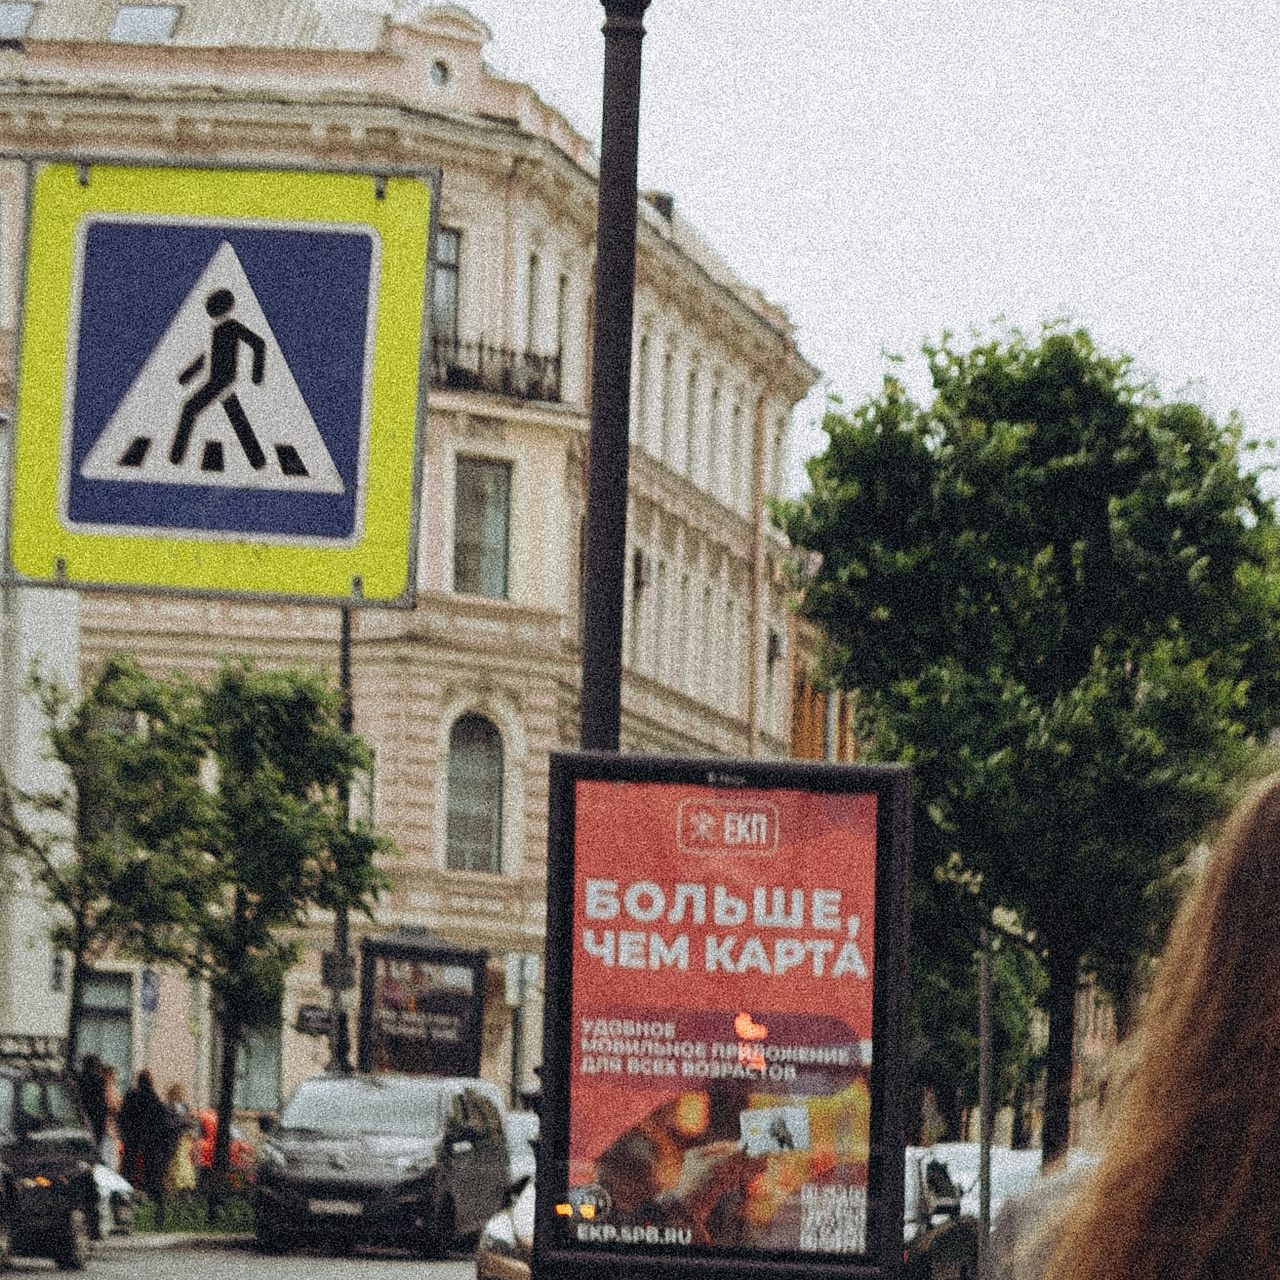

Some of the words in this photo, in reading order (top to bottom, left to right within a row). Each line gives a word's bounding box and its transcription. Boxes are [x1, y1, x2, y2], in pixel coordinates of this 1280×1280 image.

[723, 812, 768, 845] ЕКП
[584, 878, 861, 938] БОЛЬШЕ,
[582, 929, 690, 971] ЧЕМ
[704, 935, 868, 979] КАРТА
[580, 1018, 676, 1038] УДОБНОЕ
[579, 1038, 707, 1058] МОБИЛЬНОЕ
[579, 1056, 622, 1075] ДЛЯ
[626, 1057, 677, 1077] ВСЕХ
[681, 1059, 798, 1081] ВОЗРАСТОВ
